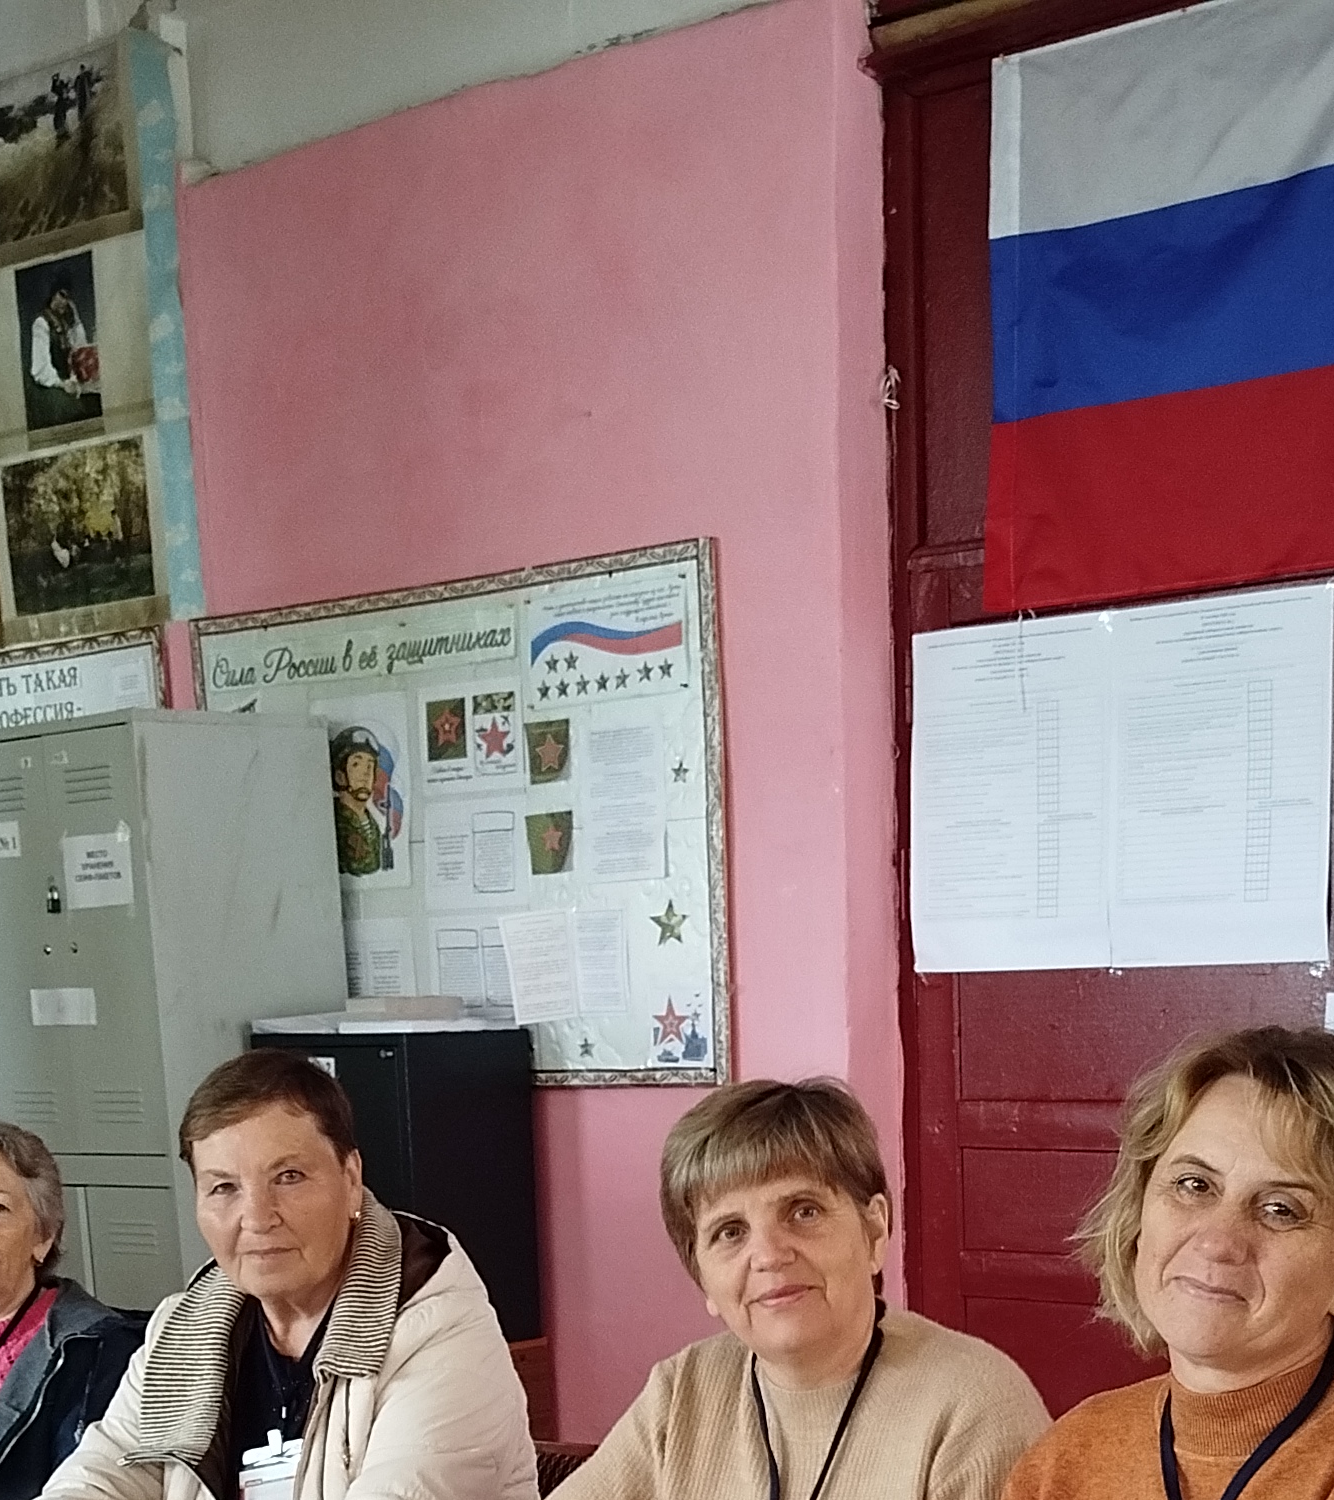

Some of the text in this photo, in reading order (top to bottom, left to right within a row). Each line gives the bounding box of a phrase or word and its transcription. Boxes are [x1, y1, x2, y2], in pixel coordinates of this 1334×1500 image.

[21, 666, 79, 693] ТАКАЯ
[212, 625, 512, 689] Сила России в её защитниках
